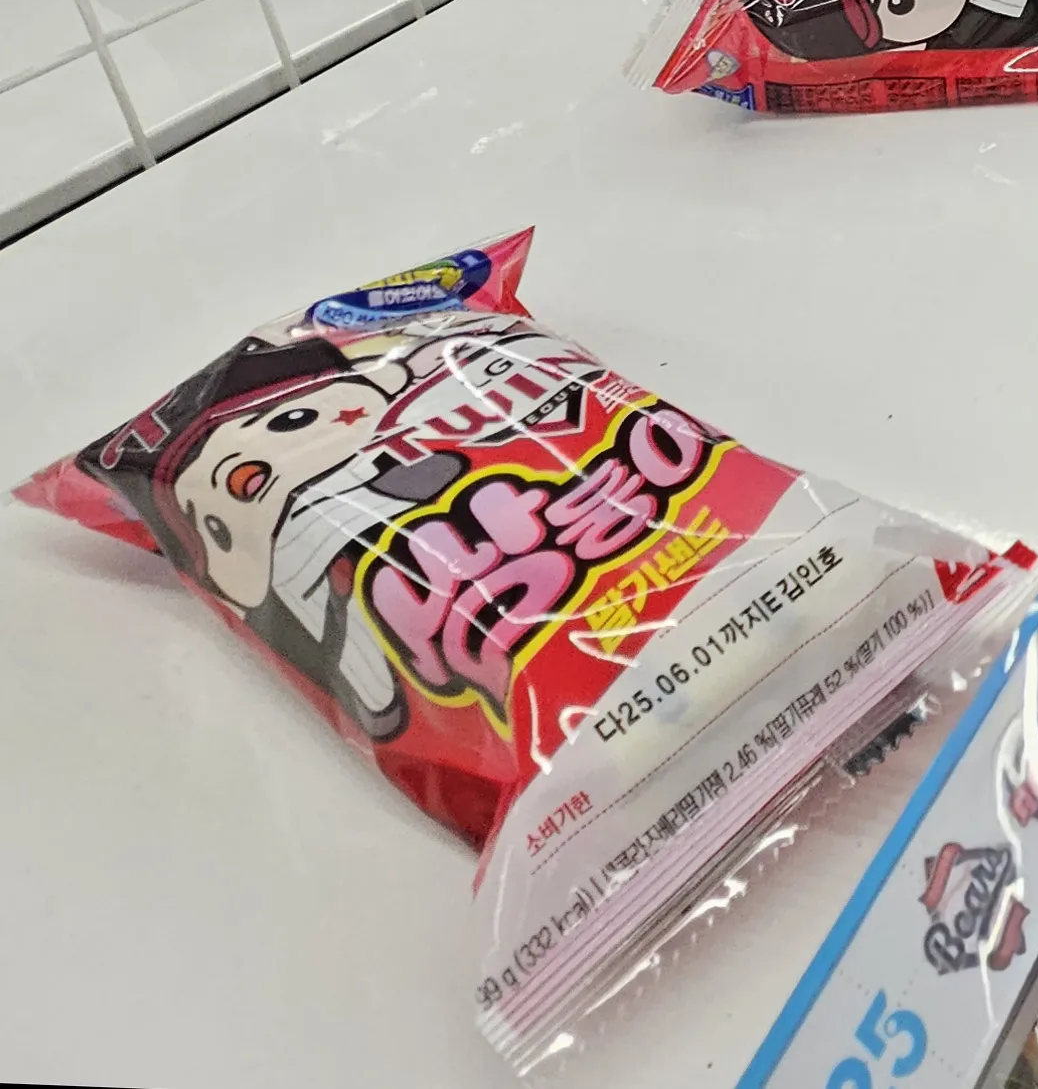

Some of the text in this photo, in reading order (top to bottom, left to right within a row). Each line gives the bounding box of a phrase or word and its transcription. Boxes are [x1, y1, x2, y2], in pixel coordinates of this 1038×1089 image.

[361, 347, 602, 468] TWIN
[585, 506, 730, 656] 딸기샌드
[820, 667, 847, 696] 52
[879, 609, 911, 641] 100
[524, 790, 595, 856] 소비기한
[924, 848, 1012, 975] Bears
